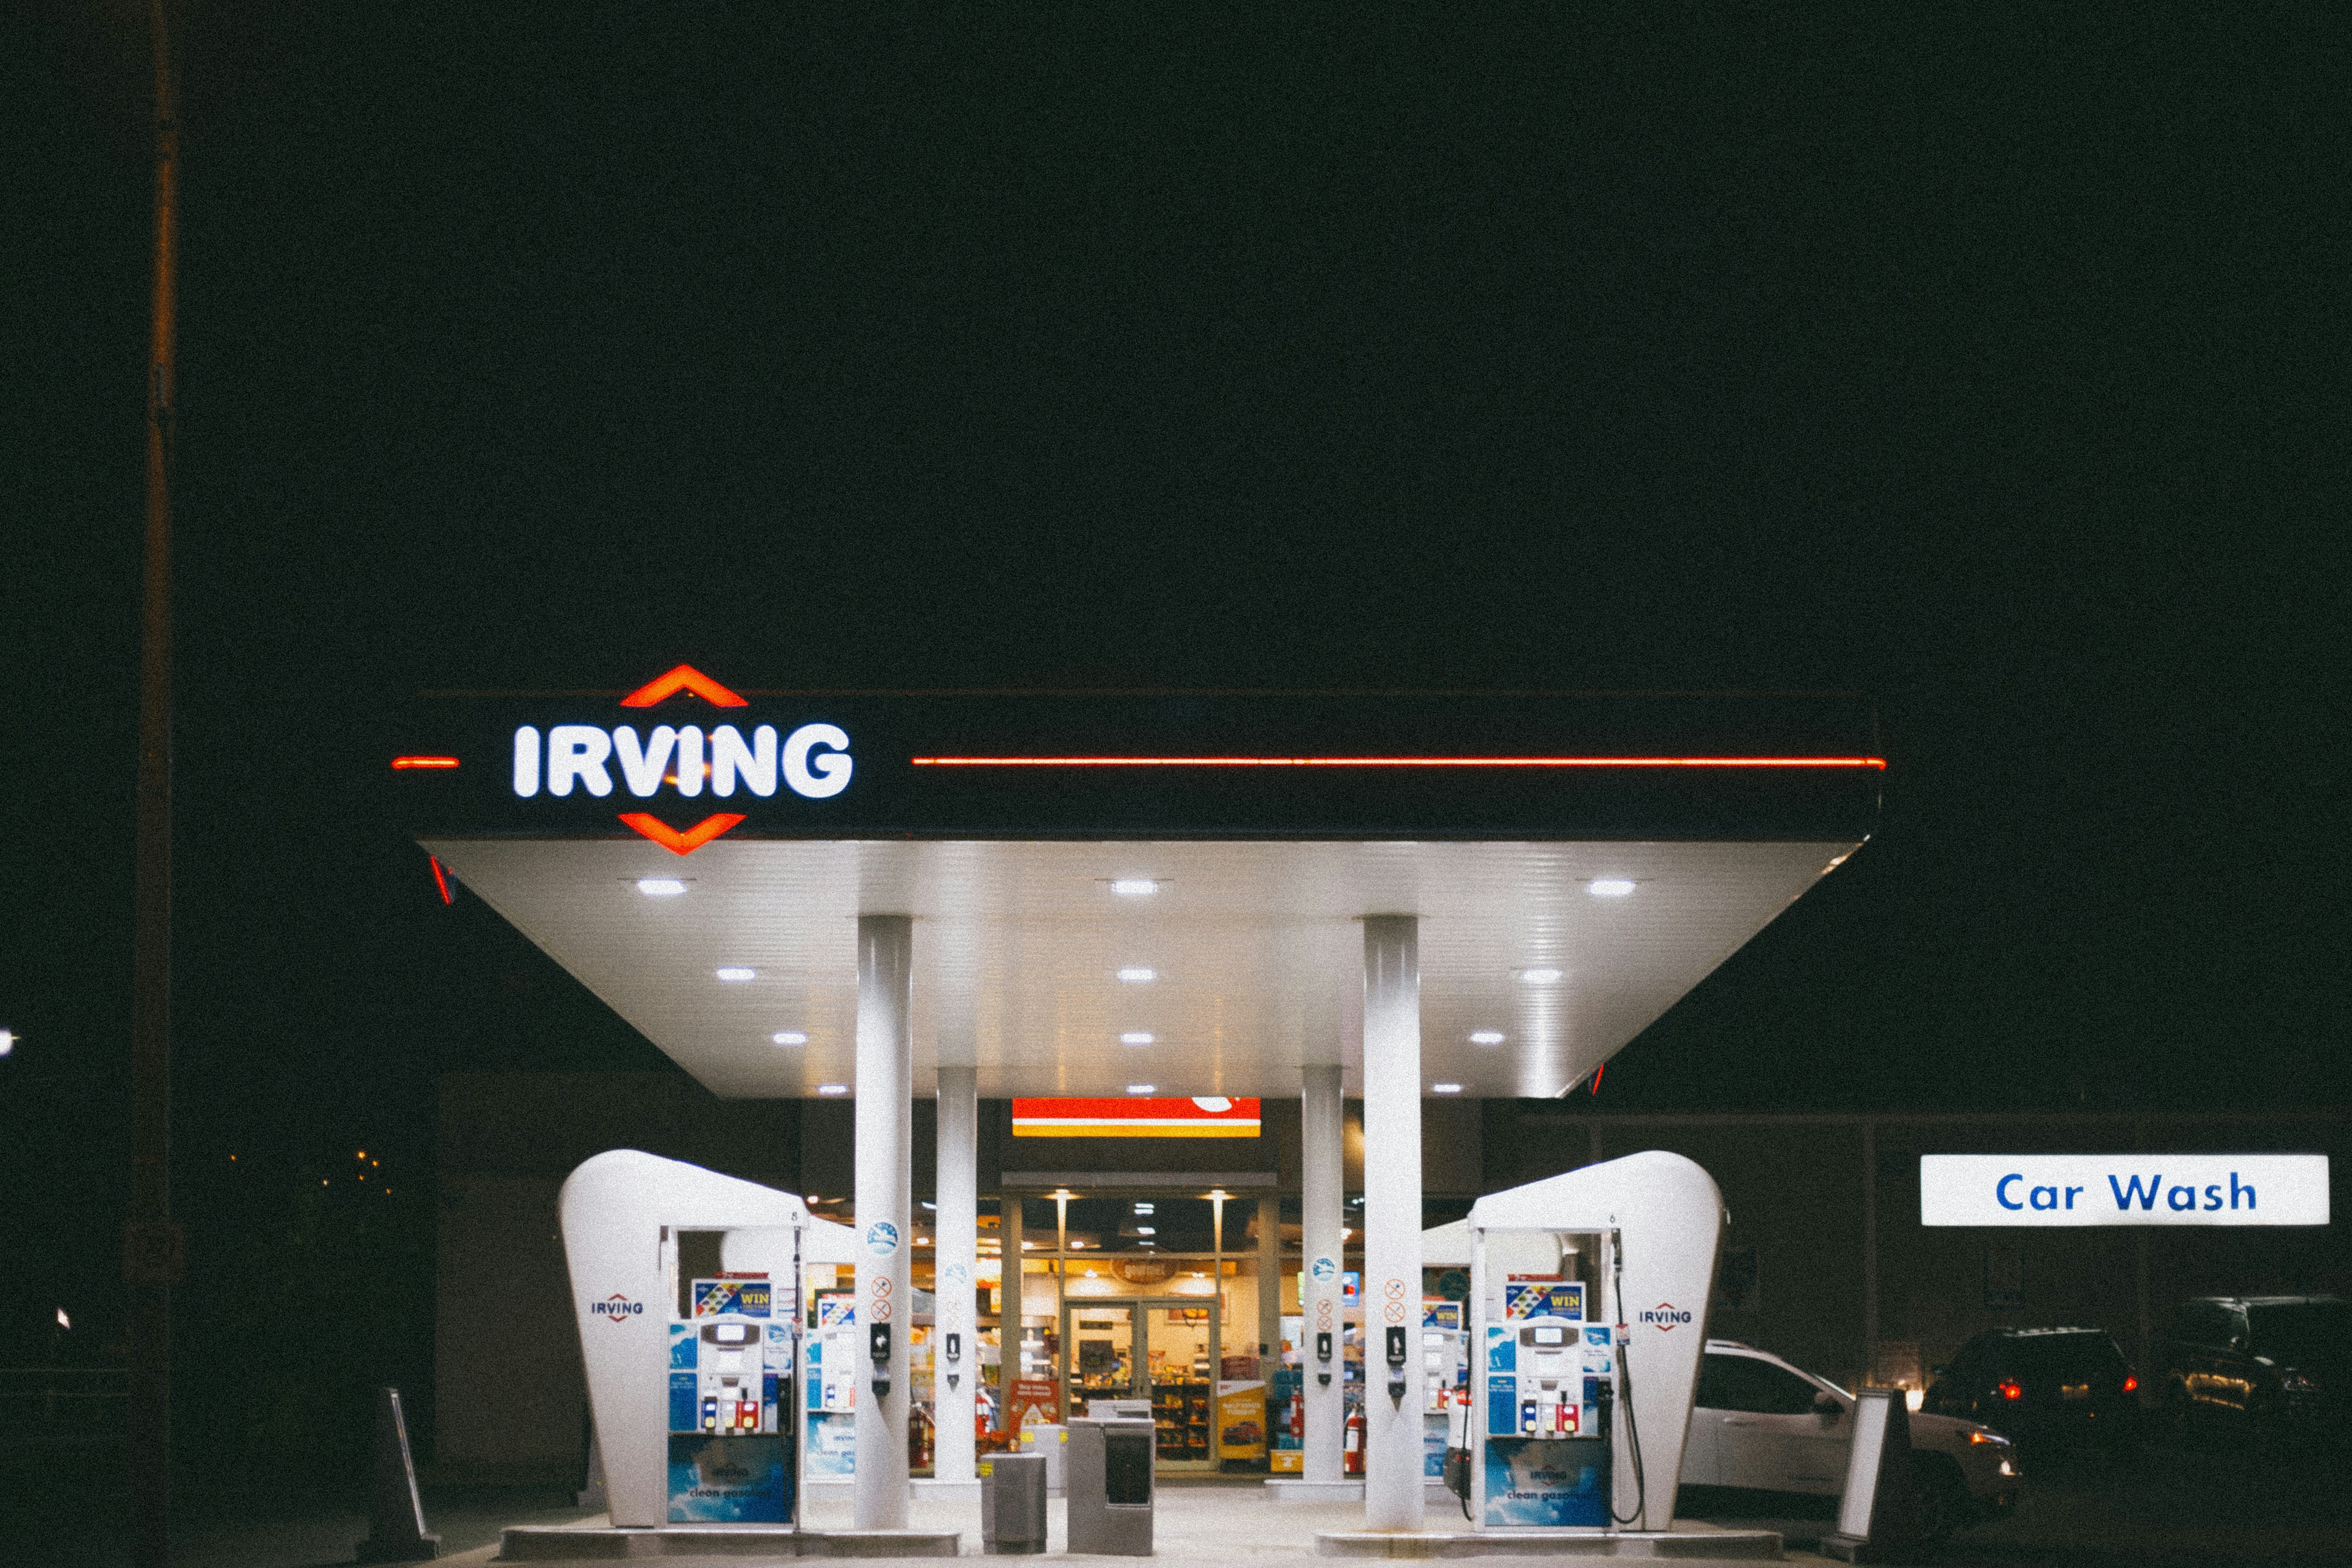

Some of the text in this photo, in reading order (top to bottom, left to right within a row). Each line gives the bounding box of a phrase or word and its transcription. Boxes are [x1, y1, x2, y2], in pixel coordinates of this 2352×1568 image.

[514, 723, 853, 798] IRVING
[1996, 1172, 2256, 1211] Car Wash
[741, 1293, 769, 1304] WIN
[1551, 1296, 1580, 1307] WIN
[591, 1302, 643, 1314] IRVING
[1640, 1311, 1691, 1323] IRVING
[689, 1488, 720, 1497] clean
[1507, 1491, 1537, 1499] clean
